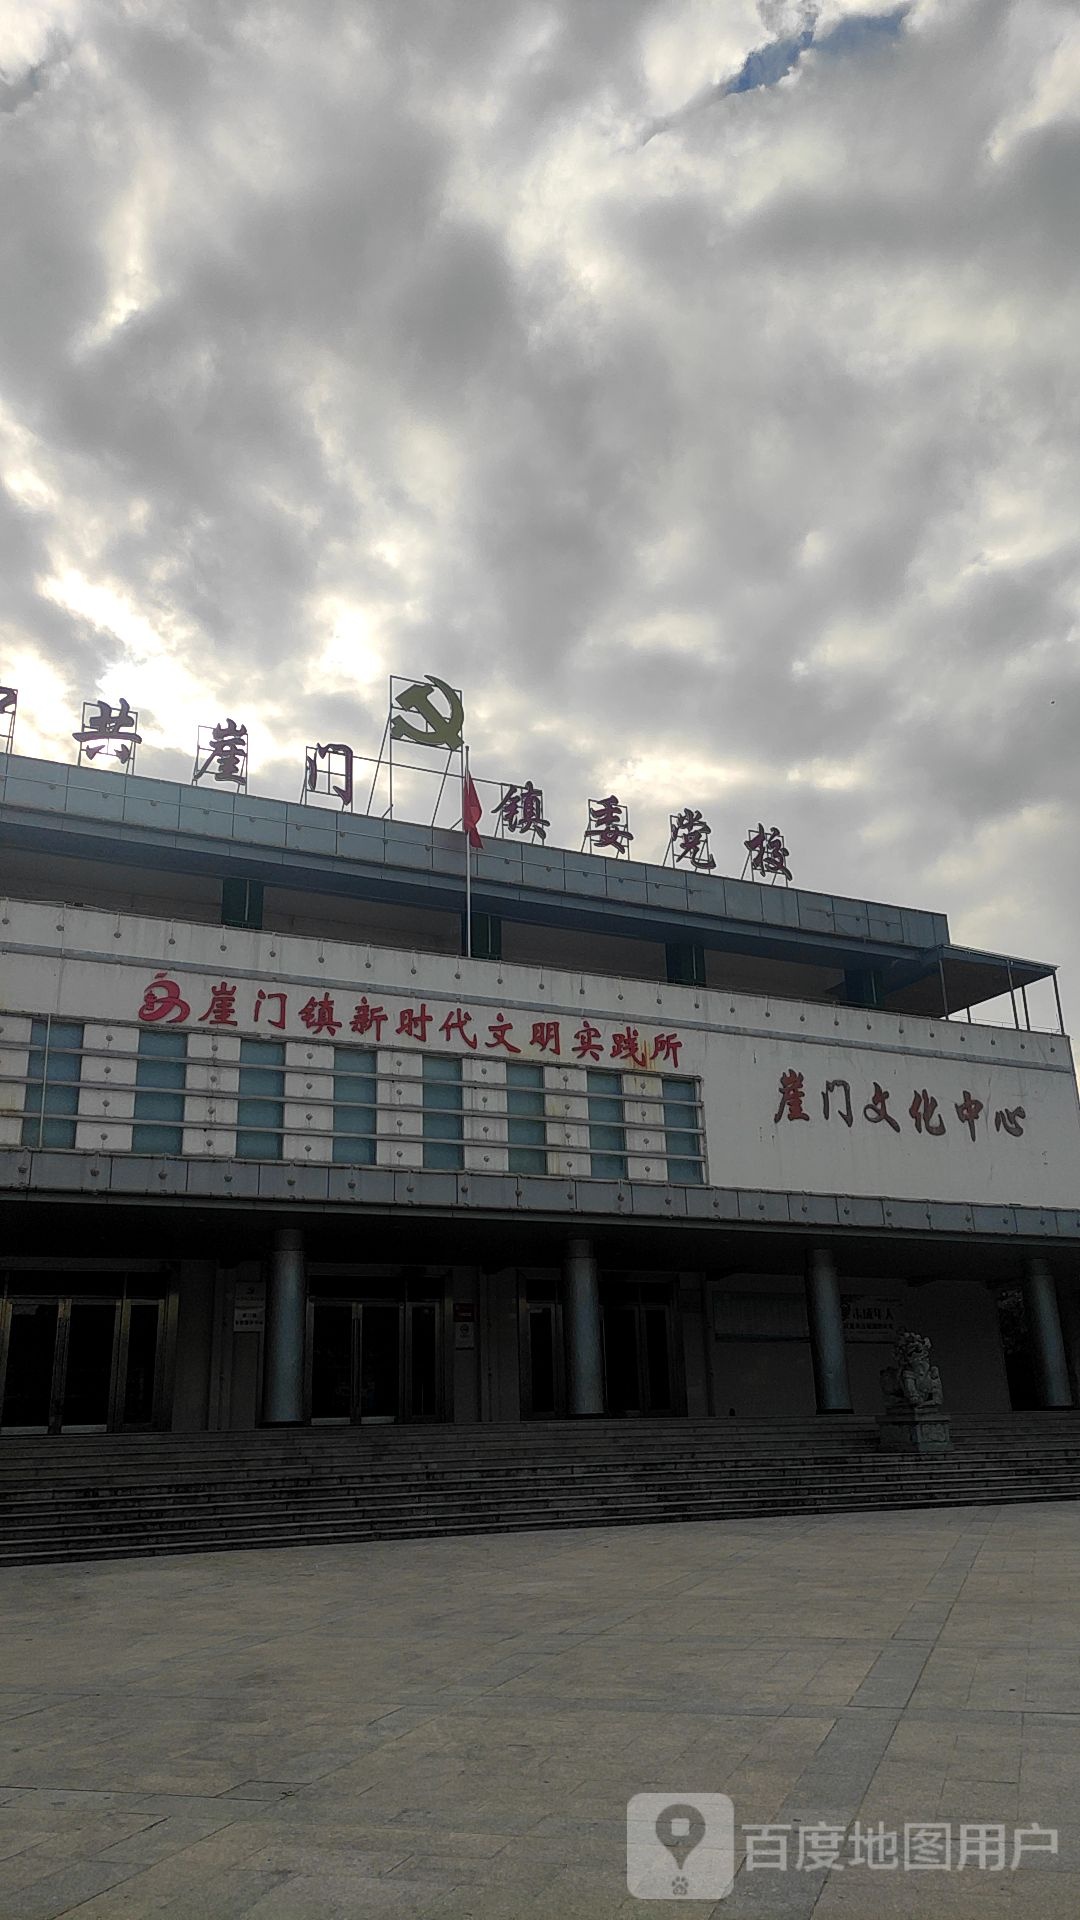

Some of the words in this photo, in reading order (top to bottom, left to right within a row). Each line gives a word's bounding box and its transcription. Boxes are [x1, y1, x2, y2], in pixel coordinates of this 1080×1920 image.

[198, 981, 683, 1068] 崖门镇新时代文明实践所
[773, 1068, 1027, 1143] 崖门文化中心
